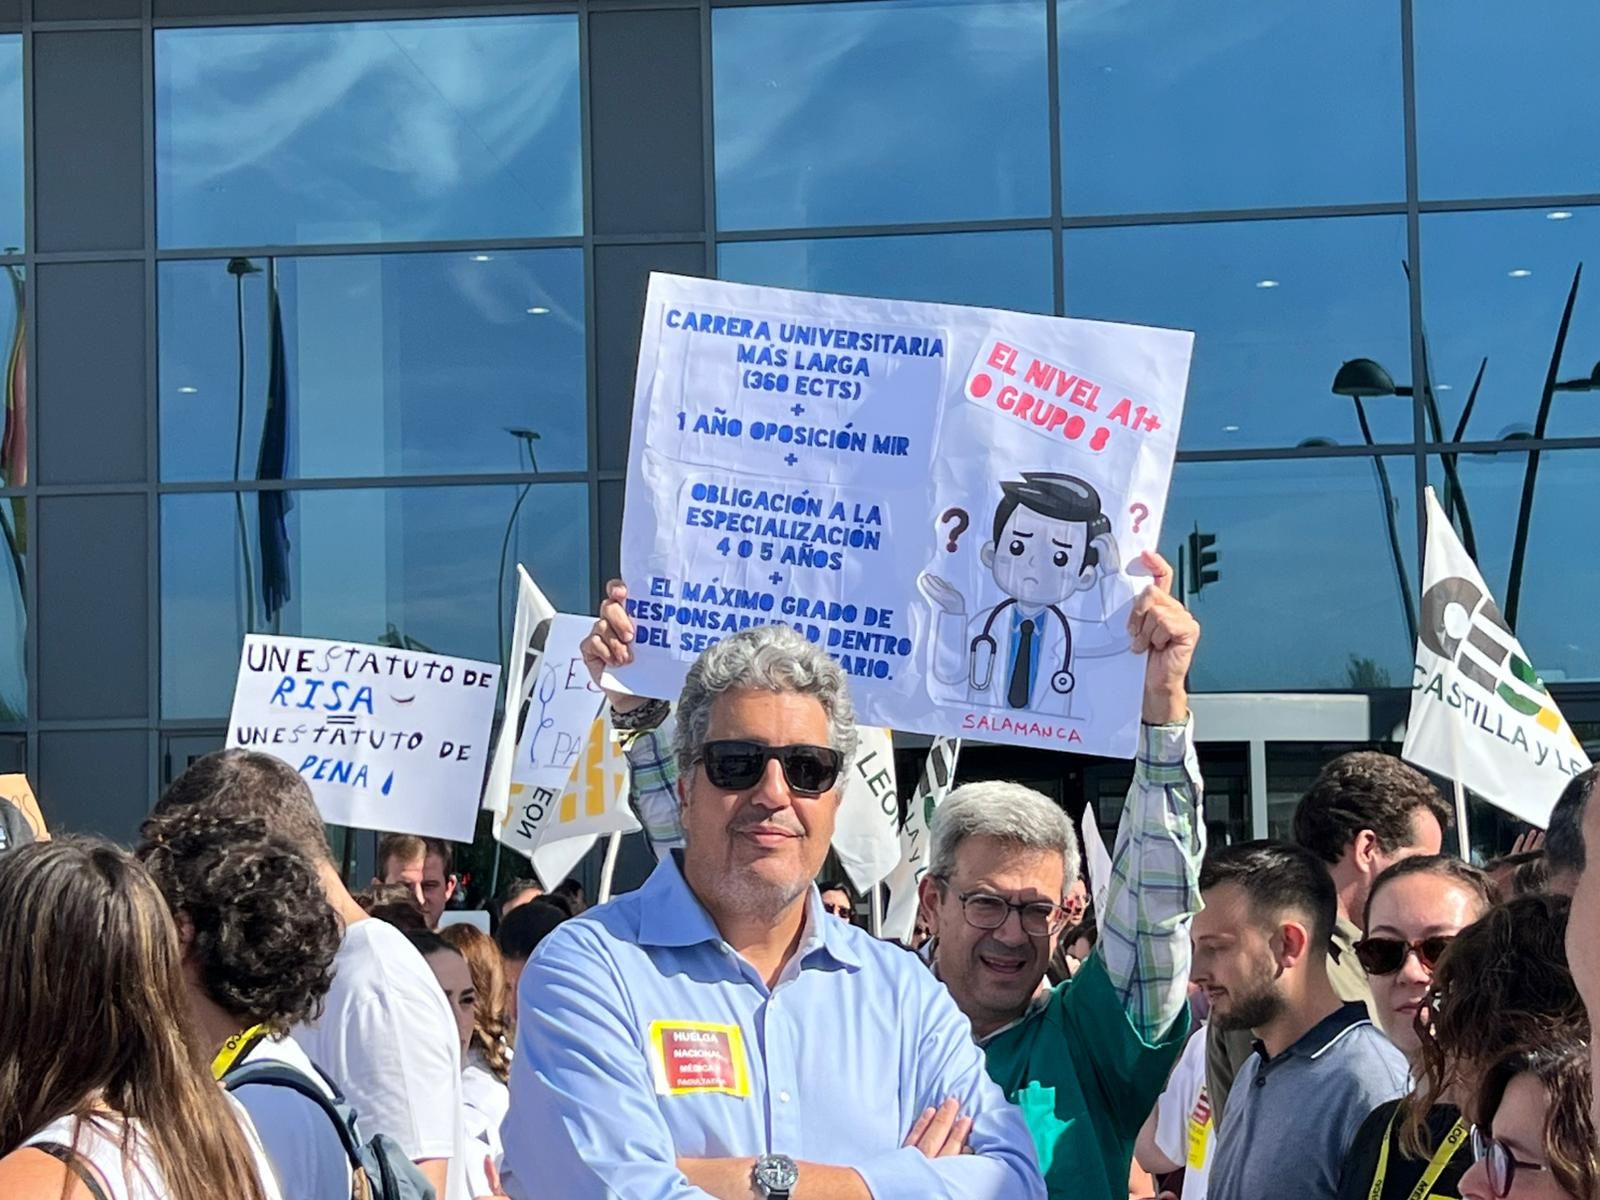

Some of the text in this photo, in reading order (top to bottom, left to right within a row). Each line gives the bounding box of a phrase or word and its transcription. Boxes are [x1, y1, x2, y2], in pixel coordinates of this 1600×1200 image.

[666, 309, 944, 358] CARRERA UNIVERSITARIA
[795, 350, 870, 377] LARGA
[743, 369, 861, 400] (360 ECTS)
[986, 341, 1161, 432] EL NIVEL A1+
[677, 406, 910, 456] 1 AÑO OPOSICIÓN MIR
[996, 385, 1086, 440] GRUPO
[691, 483, 882, 526] OBLIGACIÓN A LA
[686, 506, 881, 551] ESPECIALIZACIÓN
[717, 537, 730, 556] 4
[760, 542, 773, 562] 5
[780, 543, 843, 571] AÑOS
[650, 576, 894, 629] EL MÁXIMO GRADO DE
[626, 598, 912, 657] RESPONSABAD DENTRO
[635, 625, 671, 649] DEL
[463, 669, 493, 688] DE
[829, 652, 893, 681] ARIO.
[270, 675, 374, 715] RISA
[1411, 663, 1529, 752] CASTILLA
[962, 713, 1082, 744] SALAMANCA
[439, 741, 471, 761] DE
[298, 754, 369, 788] PENA
[672, 1031, 719, 1043] HUELGA
